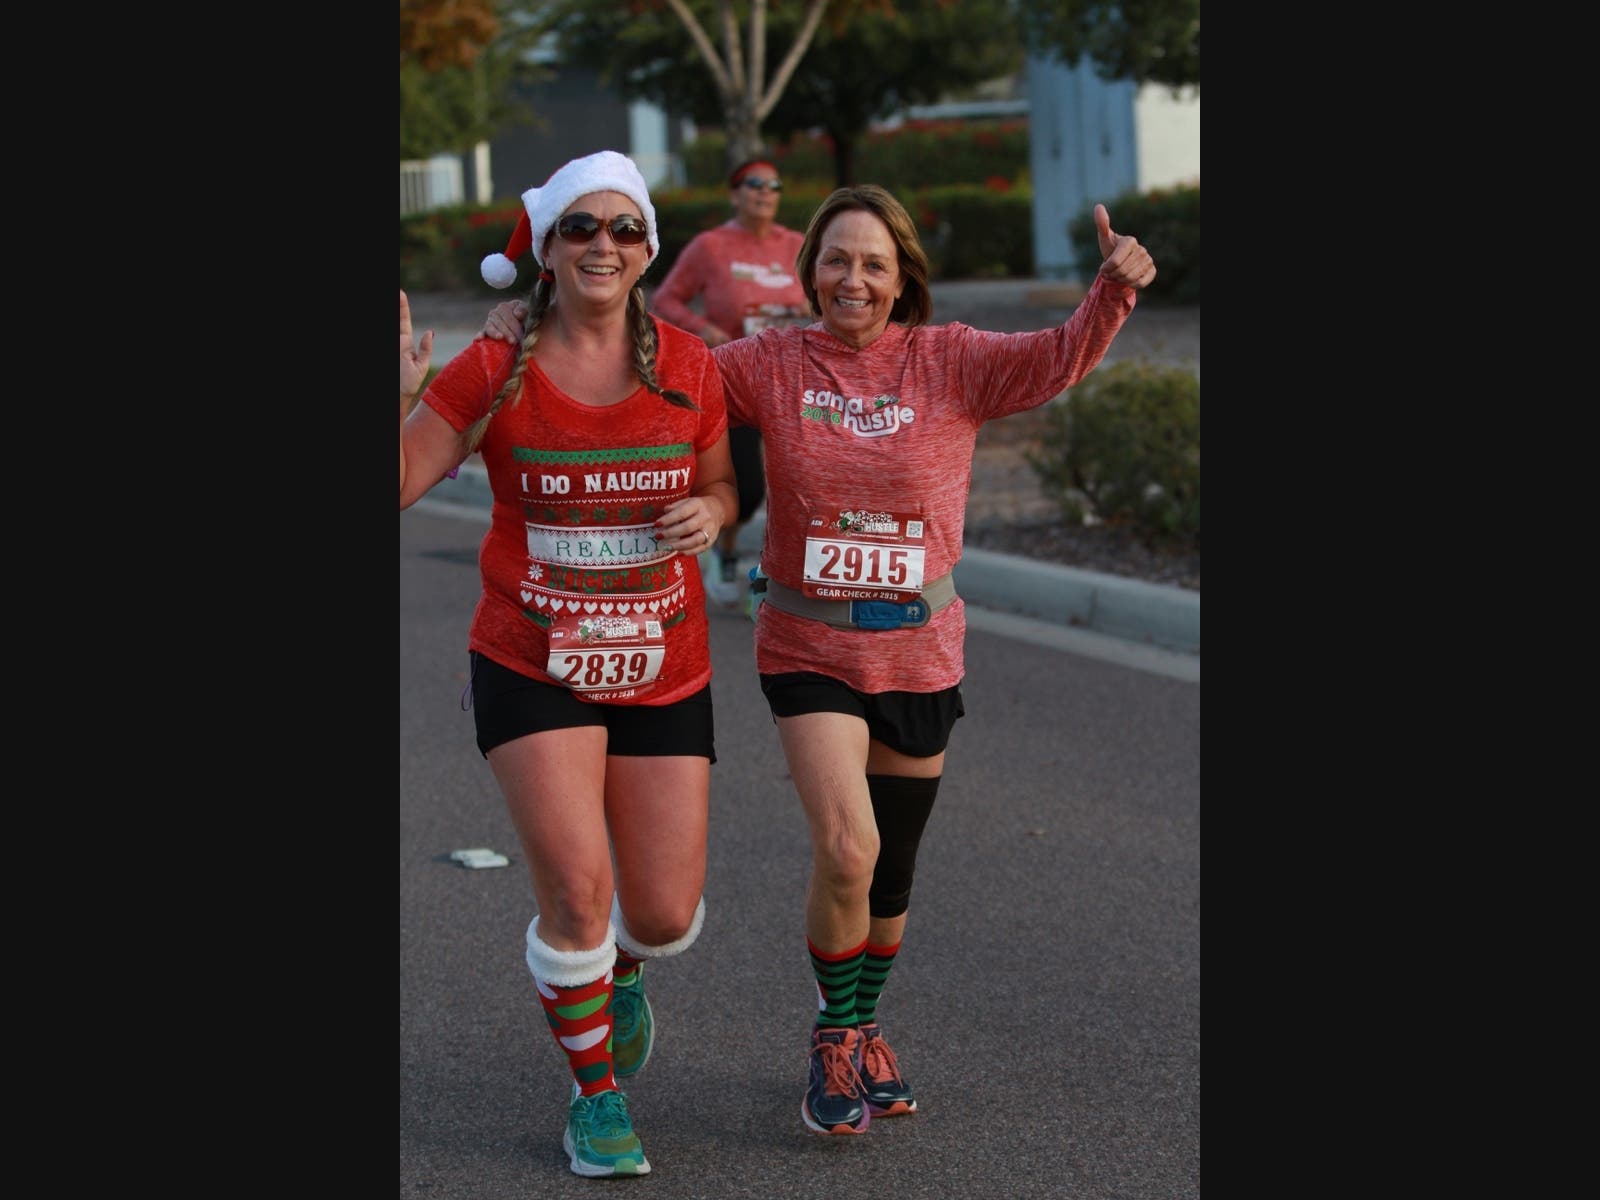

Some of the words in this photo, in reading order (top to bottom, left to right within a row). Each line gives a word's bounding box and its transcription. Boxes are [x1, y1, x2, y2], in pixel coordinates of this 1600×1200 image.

[801, 403, 841, 425] 2016
[844, 401, 915, 437] hustle
[520, 473, 529, 492] I
[541, 475, 570, 494] DO
[584, 467, 691, 493] NAUGHTY
[864, 521, 899, 533] HUSTLE
[555, 537, 661, 557] REALLY
[547, 562, 668, 594] NICELEY
[819, 544, 908, 585] 2915
[816, 588, 840, 597] GEAR
[842, 589, 871, 599] CHECK
[563, 652, 648, 686] 2839
